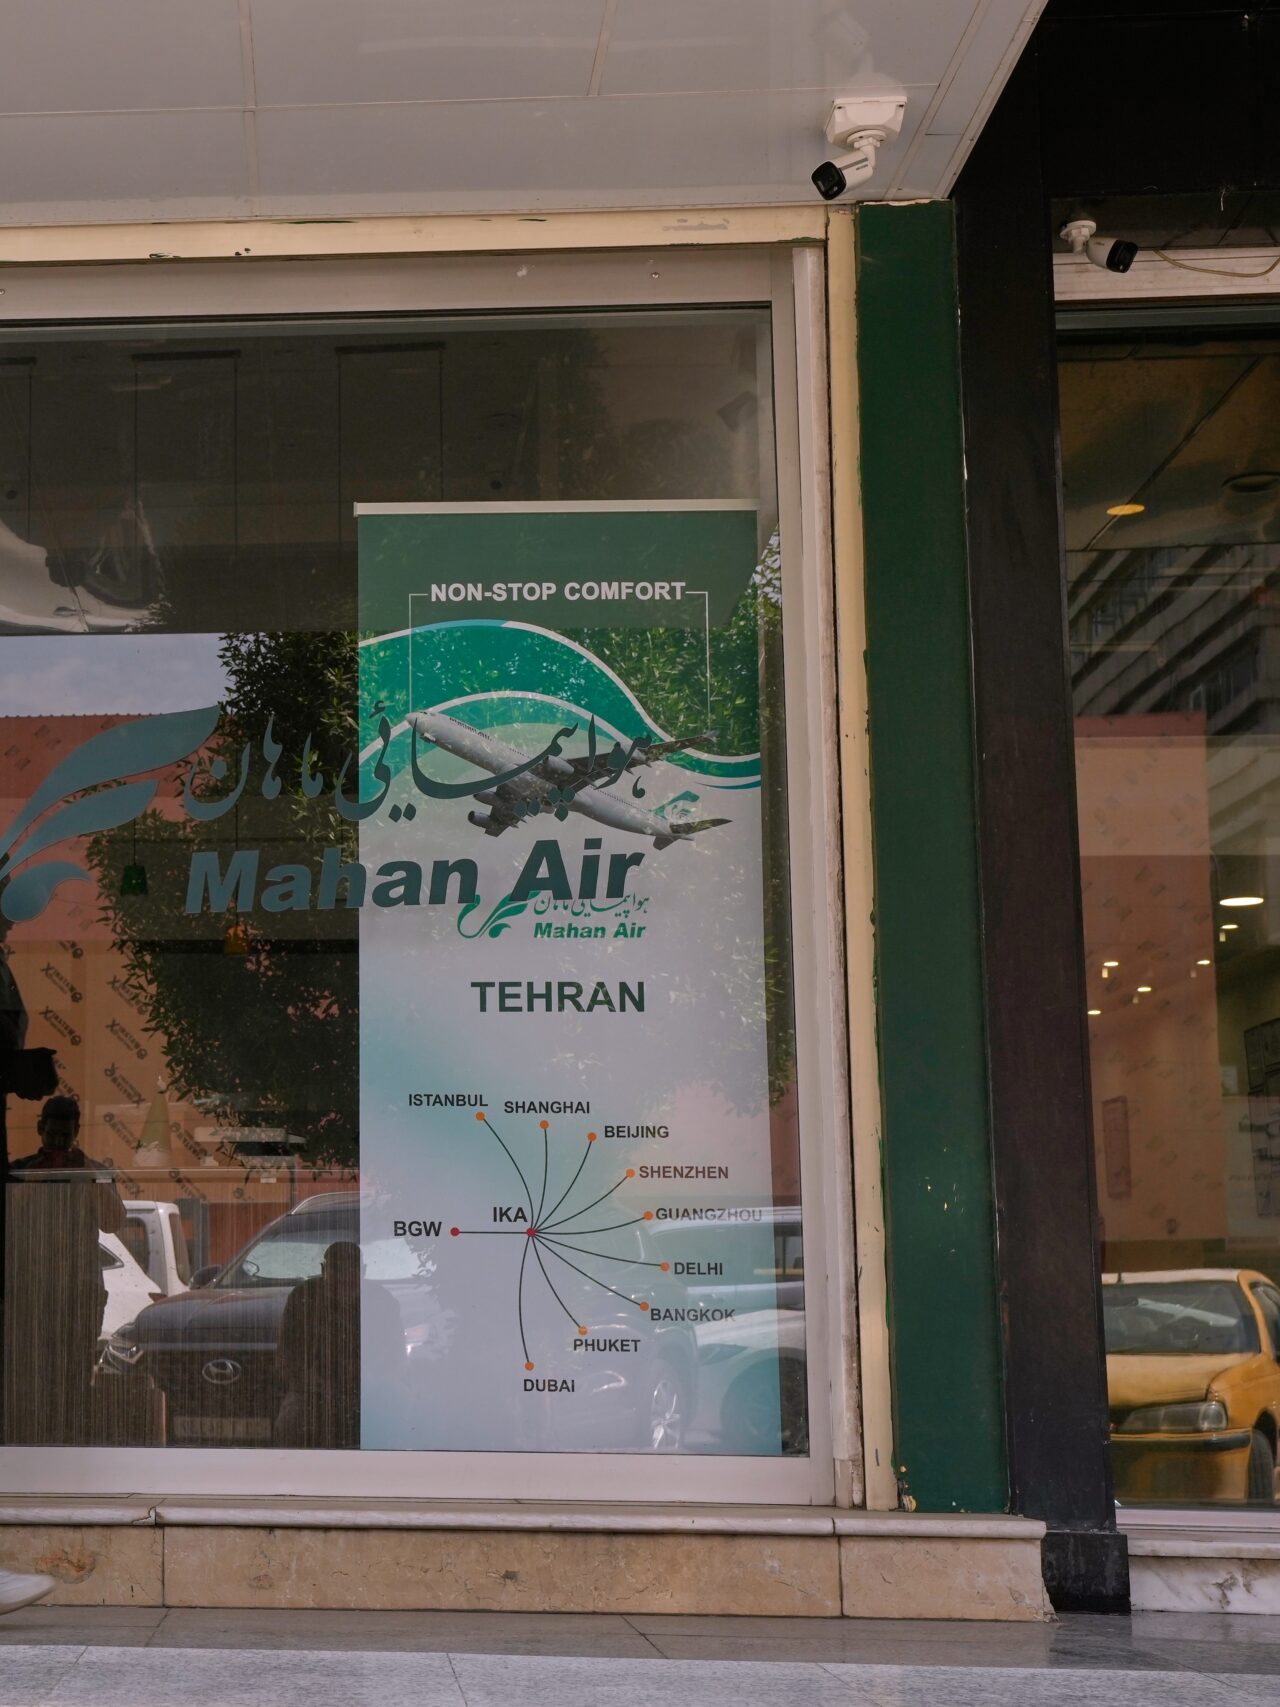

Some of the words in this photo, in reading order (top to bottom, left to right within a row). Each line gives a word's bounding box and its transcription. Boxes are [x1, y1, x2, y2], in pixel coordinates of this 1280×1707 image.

[431, 582, 557, 602] NON-STOP
[564, 581, 686, 601] COMFORT
[184, 846, 479, 915] Mahan
[508, 837, 645, 901] Air
[533, 922, 607, 939] Mahan
[613, 922, 646, 939] Air
[470, 981, 646, 1013] TEHRAN
[408, 1093, 488, 1107] ISTANBUL
[504, 1100, 590, 1114] SHANGHAI
[604, 1125, 669, 1139] BEIJING
[639, 1165, 729, 1179] SHENZHEN
[492, 1206, 528, 1223] IKA
[655, 1207, 762, 1222] GUANGZHOU
[393, 1220, 442, 1238] BGW
[673, 1262, 723, 1275] DELHI
[650, 1307, 736, 1322] BANGKOK
[573, 1338, 641, 1353] PHUKET
[523, 1378, 575, 1393] DUBAI
